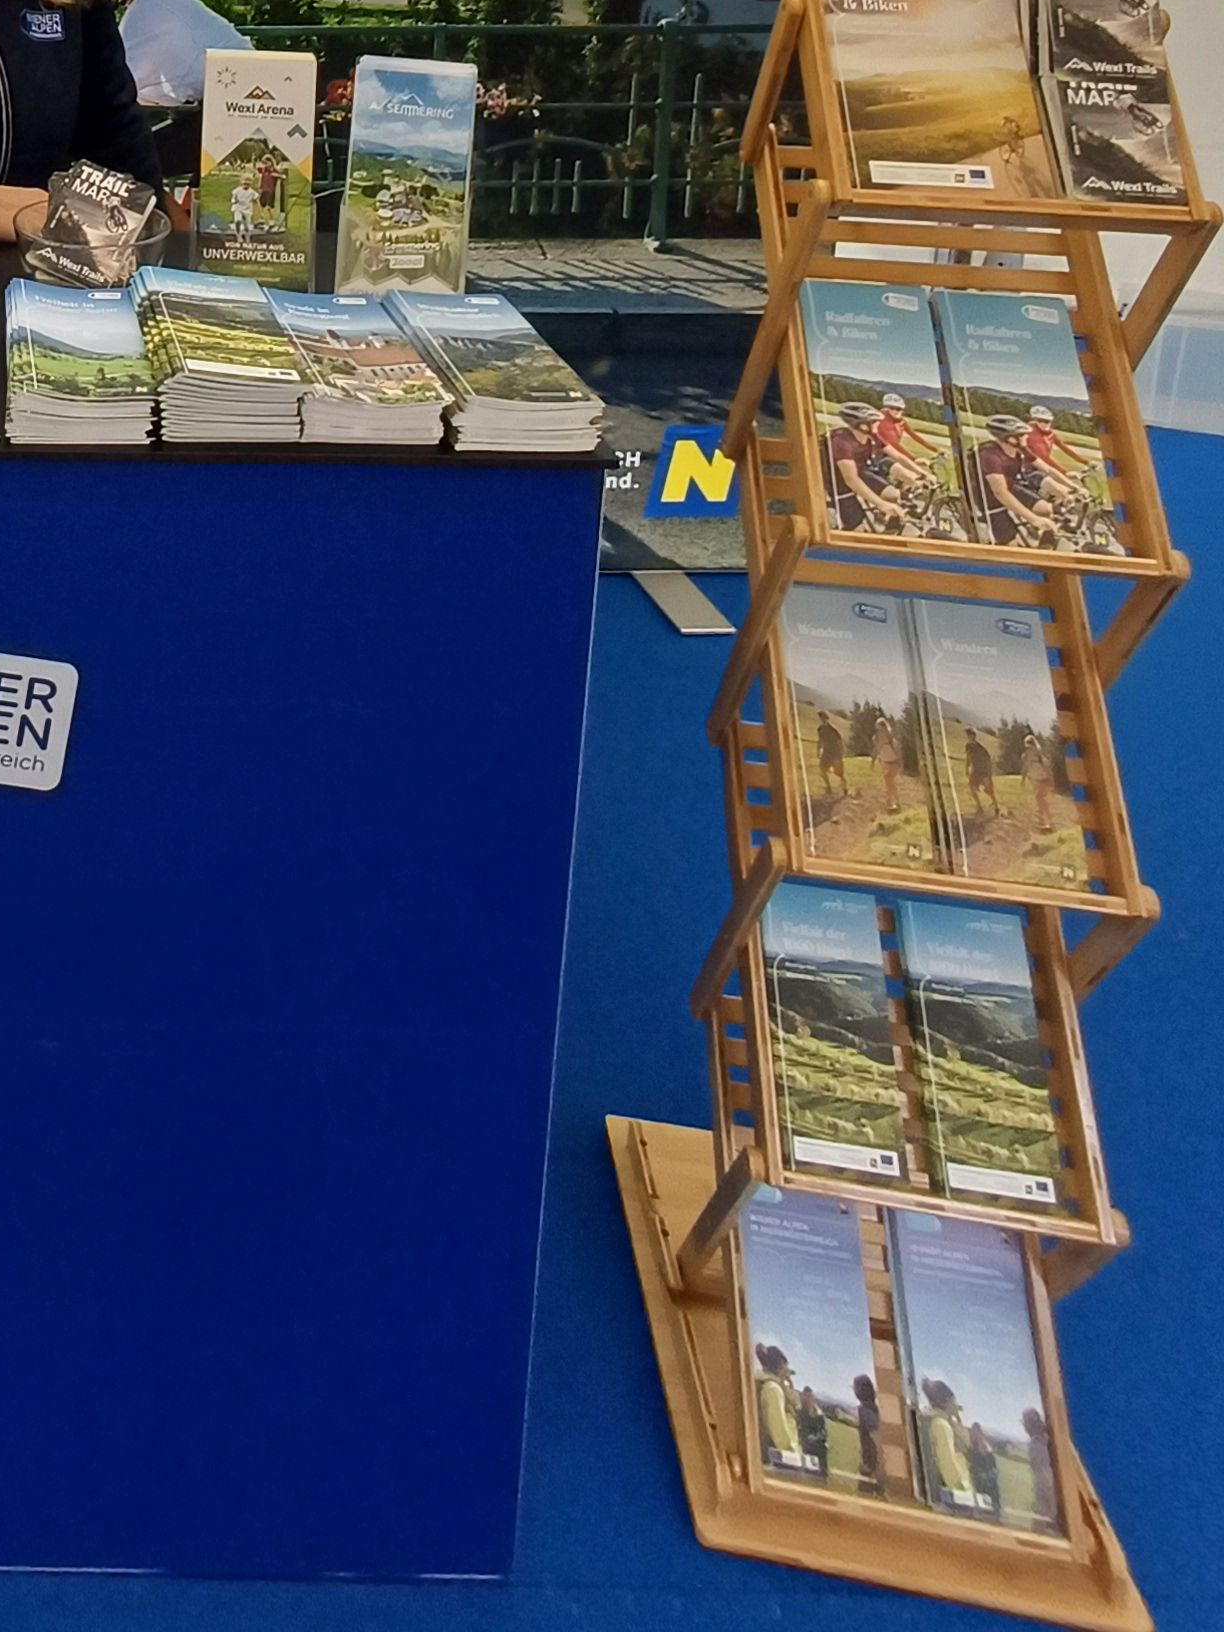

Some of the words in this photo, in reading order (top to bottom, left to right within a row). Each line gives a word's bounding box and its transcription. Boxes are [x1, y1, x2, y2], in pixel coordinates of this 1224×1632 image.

[1092, 61, 1123, 73] Wexl
[1125, 63, 1158, 74] Trails
[1066, 88, 1115, 106] MAP
[226, 102, 255, 114] Wexl
[257, 104, 294, 116] Arena
[387, 103, 454, 119] SEMMERING
[80, 165, 129, 198] TRAIL
[1111, 181, 1142, 192] Wexl
[1143, 182, 1177, 194] Trails
[203, 247, 305, 264] UNVERWEXLBAR
[59, 255, 82, 273] Wexl
[80, 265, 105, 283] Trails
[797, 623, 853, 640] Wandern
